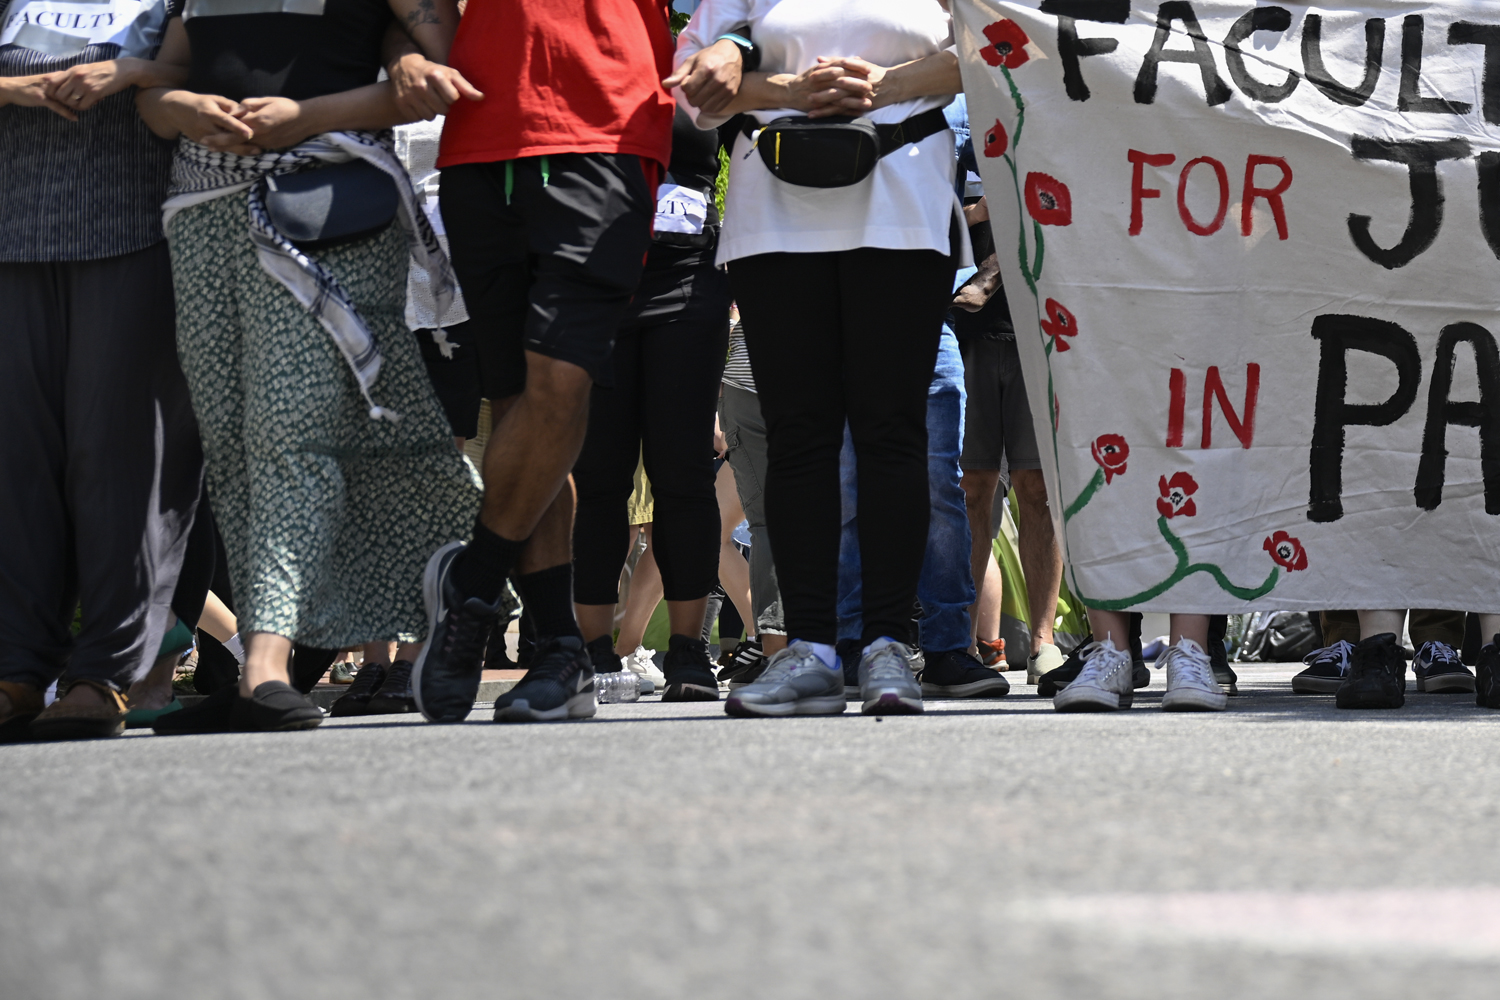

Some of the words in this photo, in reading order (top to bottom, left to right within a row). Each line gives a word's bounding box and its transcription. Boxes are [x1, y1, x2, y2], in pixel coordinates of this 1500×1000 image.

[7, 10, 123, 30] FACULTY
[1126, 148, 1294, 241] FOR
[1165, 362, 1261, 450] IN
